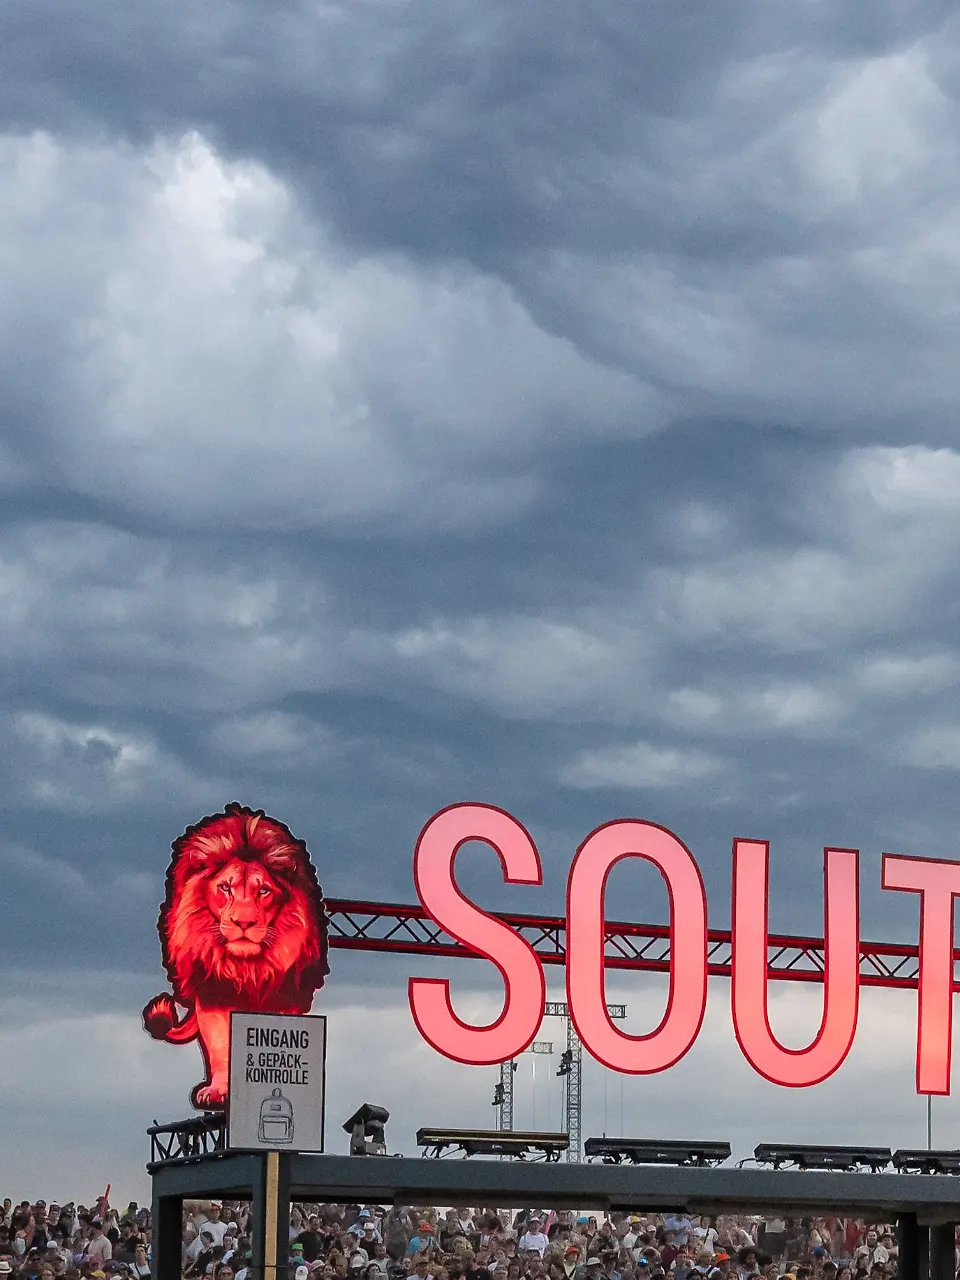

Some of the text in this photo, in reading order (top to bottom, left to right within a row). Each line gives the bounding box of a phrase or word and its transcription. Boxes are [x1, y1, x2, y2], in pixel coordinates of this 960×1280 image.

[246, 1027, 309, 1049] EINGANG
[246, 1051, 309, 1069] & GEPÄCK-
[245, 1067, 309, 1085] KONTROLLE
